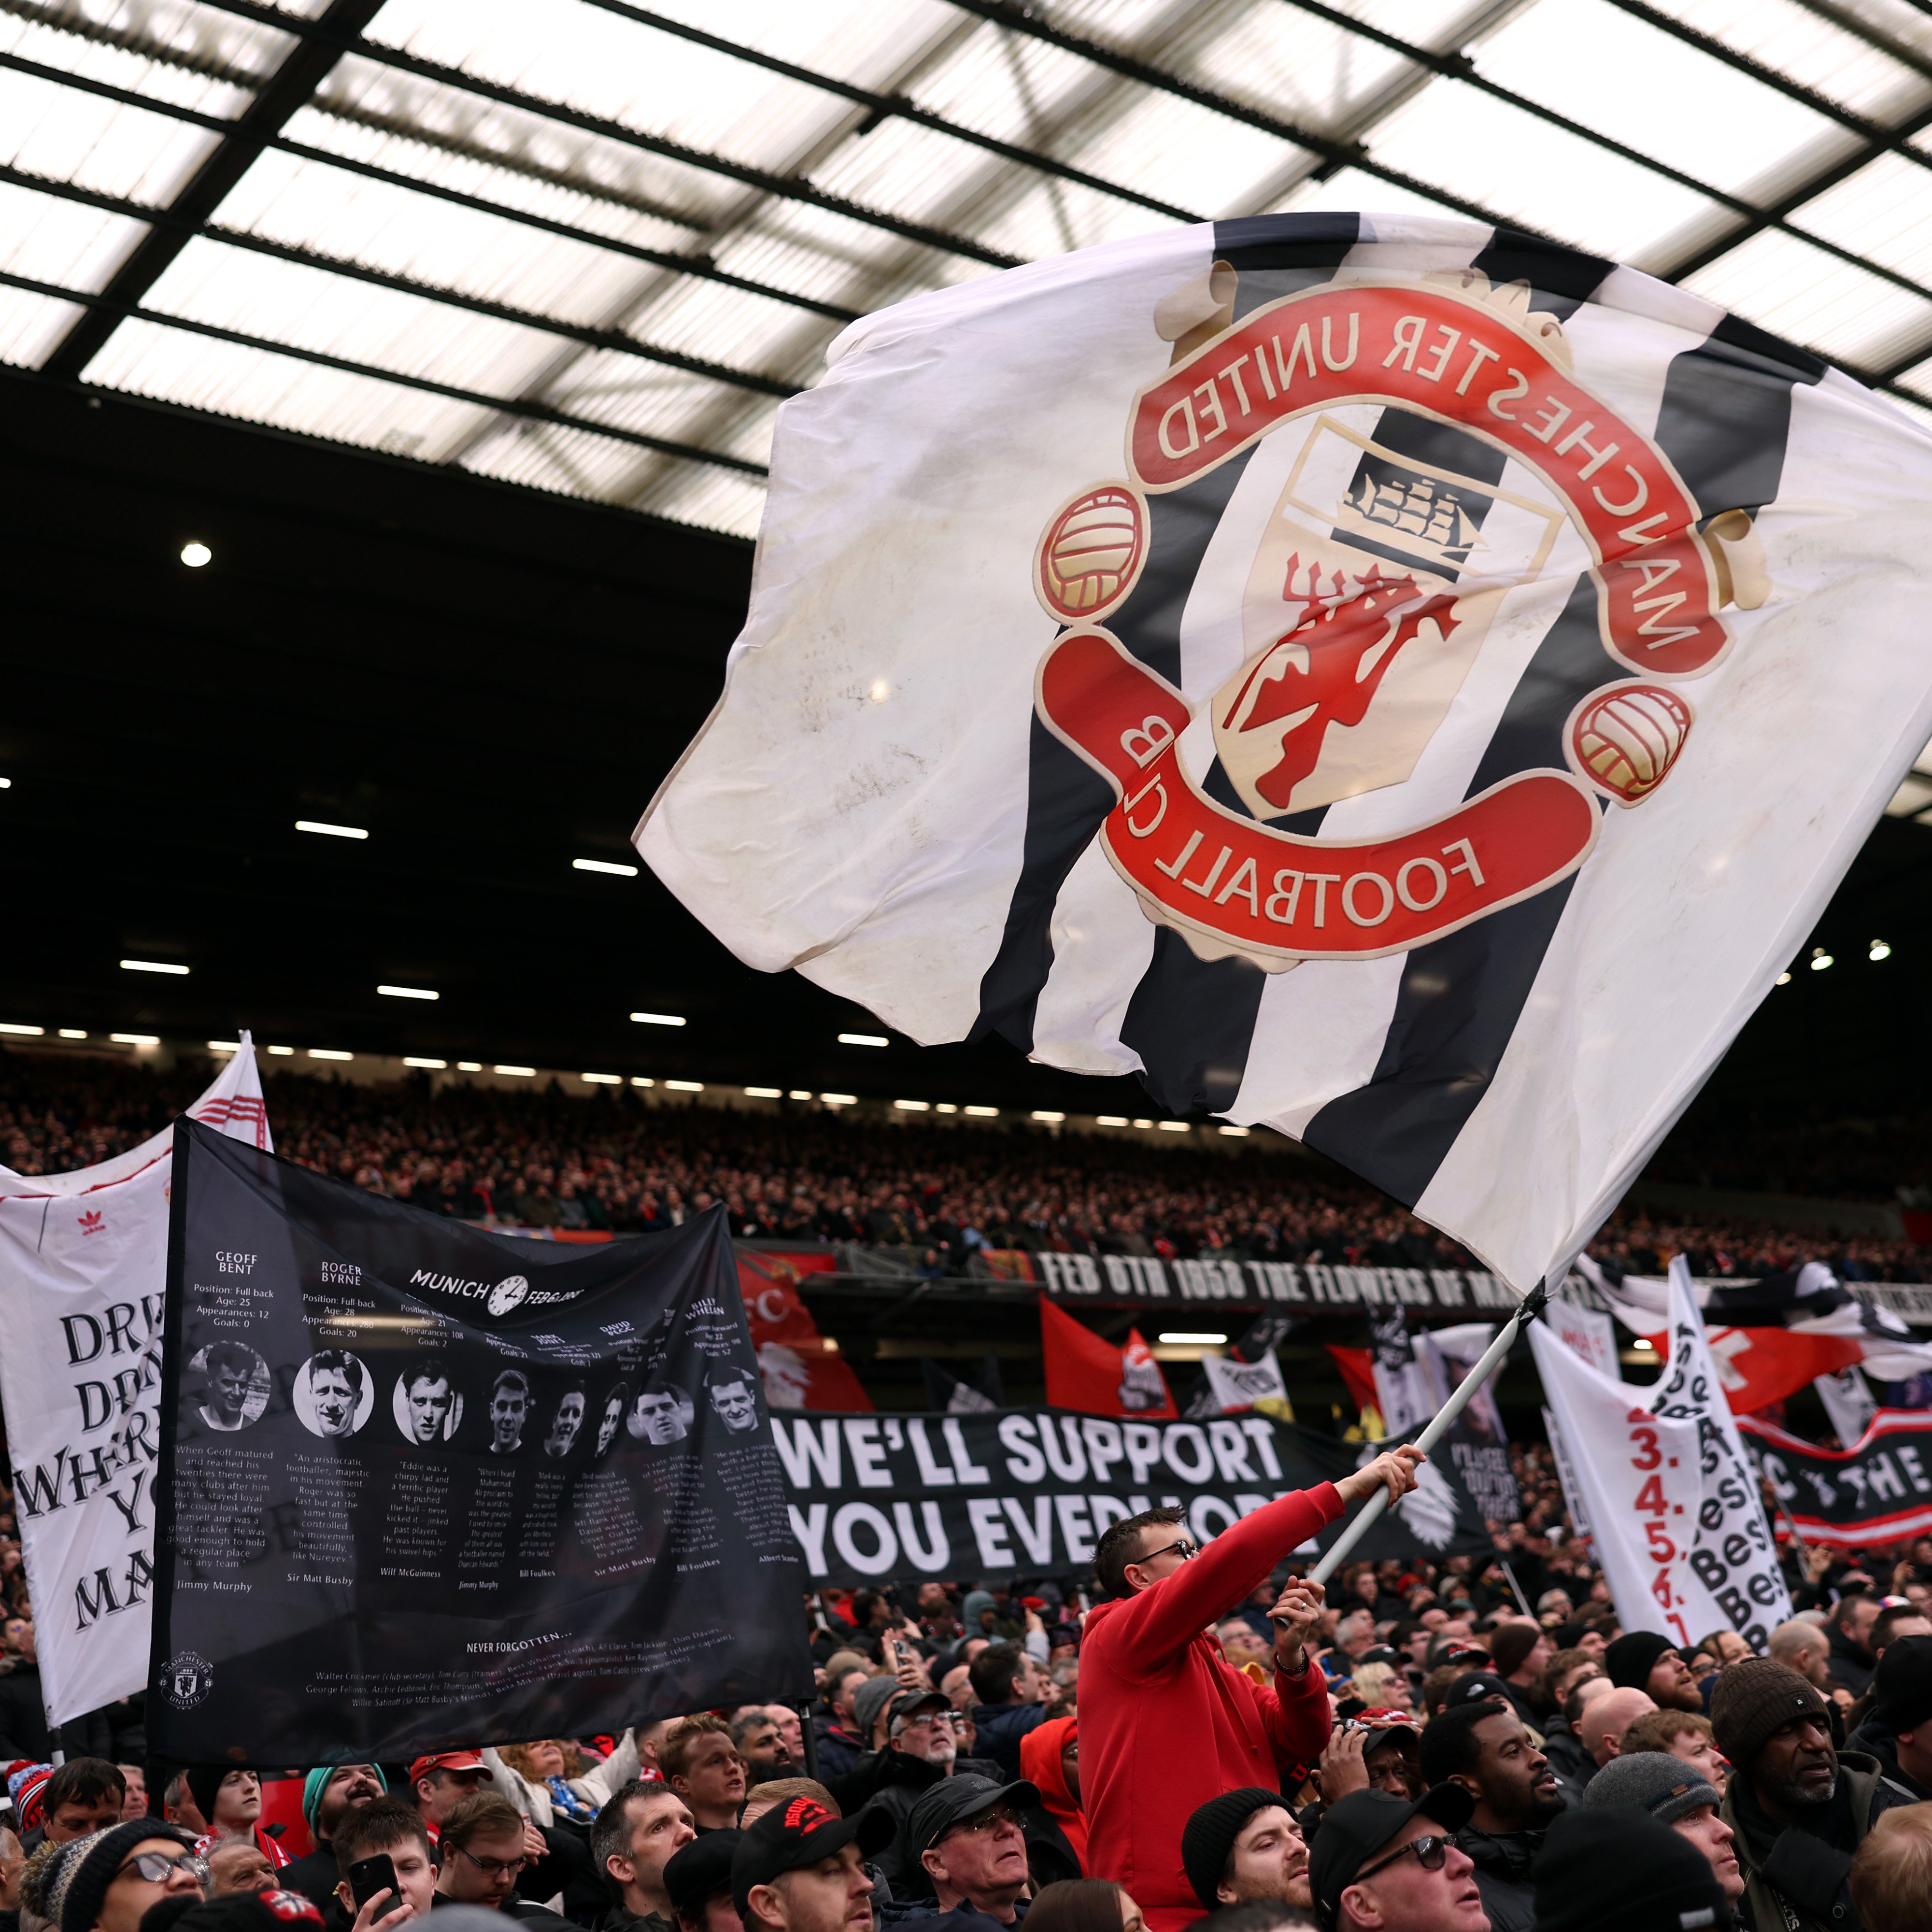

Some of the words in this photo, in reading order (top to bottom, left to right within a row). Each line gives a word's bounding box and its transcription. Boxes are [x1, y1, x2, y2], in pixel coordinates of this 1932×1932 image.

[216, 1251, 257, 1264] GEOFF
[219, 1262, 253, 1275] BENT
[322, 1262, 362, 1276] ROGER
[322, 1272, 361, 1286] BYRNE
[410, 1269, 490, 1299] MUNICH
[1037, 1251, 1102, 1294] FEB
[1102, 1254, 1170, 1297] 6TH
[1245, 1260, 1307, 1301] THE
[1305, 1264, 1432, 1305] FLOWERS
[194, 1284, 232, 1294] Position:
[216, 1297, 236, 1307] Age:
[303, 1294, 338, 1304] Position:
[197, 1306, 255, 1318] Appearances:
[259, 1310, 269, 1319] 12
[324, 1306, 342, 1316] Age:
[400, 1305, 429, 1315] Position:
[213, 1318, 241, 1327] Goals:
[302, 1315, 357, 1327] Appearances:
[420, 1318, 436, 1327] Age:
[319, 1327, 344, 1336] Goals:
[401, 1326, 449, 1338] Appearances:
[452, 1331, 464, 1339] 108
[418, 1337, 441, 1347] Goals:
[771, 1417, 990, 1489] WE'LL
[998, 1414, 1282, 1485] SUPPORT
[1630, 1428, 1679, 1470] 3.
[1634, 1475, 1684, 1516] 4.
[787, 1501, 951, 1577] YOU
[609, 1563, 629, 1572] Matt
[631, 1556, 656, 1566] Busby
[398, 1569, 441, 1577] McGuinness
[177, 1580, 209, 1591] Jimmy
[213, 1581, 252, 1592] Murphy
[287, 1573, 300, 1582] Sir
[304, 1575, 321, 1583] Matt
[326, 1576, 353, 1587] Busby
[459, 1581, 477, 1590] Jimmy
[467, 1643, 493, 1653] NEVER
[165, 1656, 209, 1674] MANCHESTER
[170, 1695, 199, 1705] UNITED
